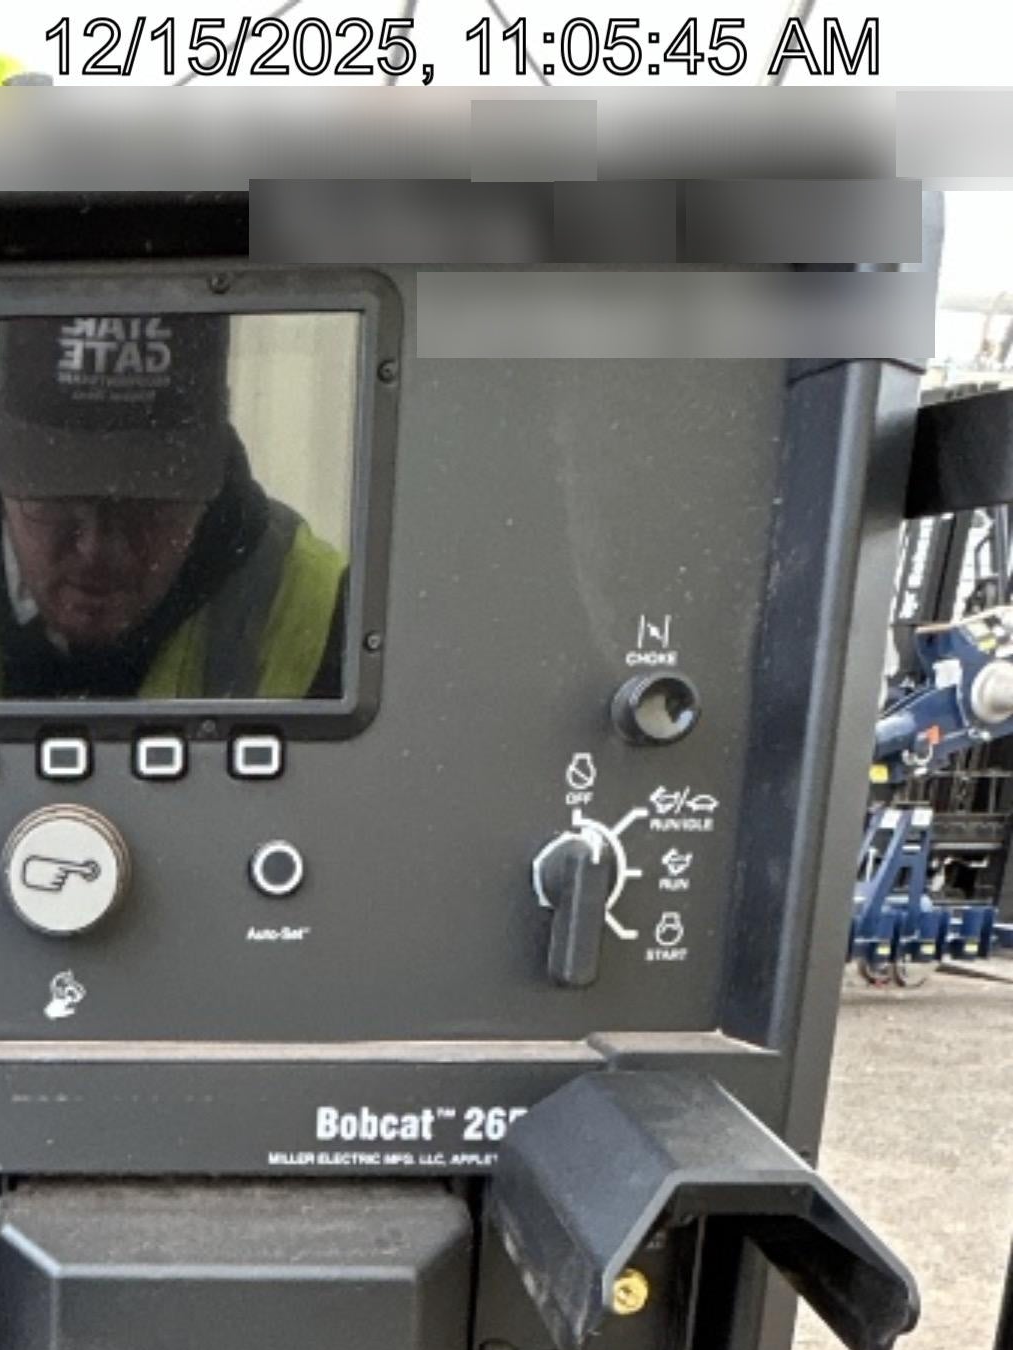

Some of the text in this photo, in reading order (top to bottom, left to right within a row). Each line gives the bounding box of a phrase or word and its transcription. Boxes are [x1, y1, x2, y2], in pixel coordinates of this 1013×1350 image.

[625, 652, 678, 667] CHOKE
[566, 792, 594, 806] OFF
[649, 817, 714, 832] RUN/IDLE
[659, 877, 690, 890] RUN
[646, 948, 688, 962] START
[268, 1151, 315, 1166] MILLER
[316, 1151, 381, 1166] ELECTRIC
